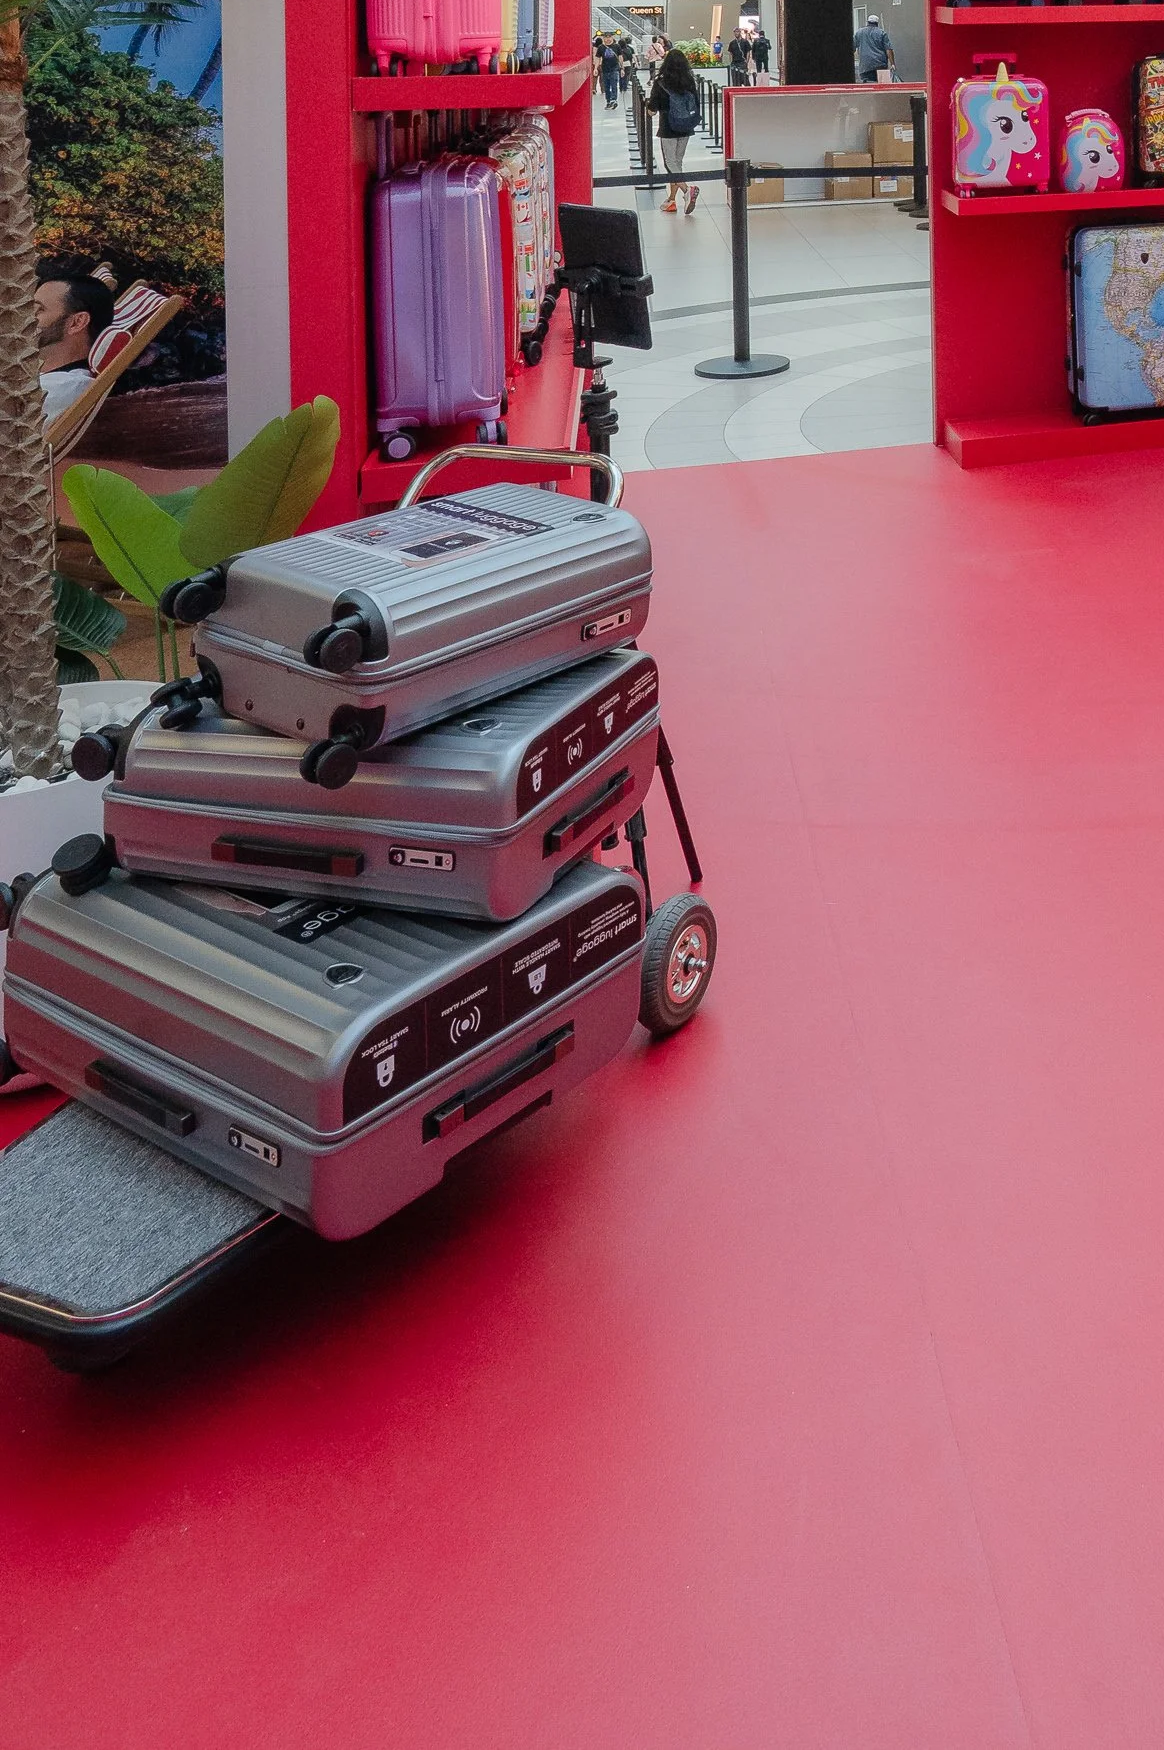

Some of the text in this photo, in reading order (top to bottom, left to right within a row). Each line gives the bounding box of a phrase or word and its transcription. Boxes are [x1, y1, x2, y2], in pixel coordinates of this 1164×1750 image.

[630, 7, 654, 15] Queen
[431, 501, 475, 515] smart
[615, 913, 637, 935] smart
[361, 1025, 408, 1058] SMART TSA LOCK
